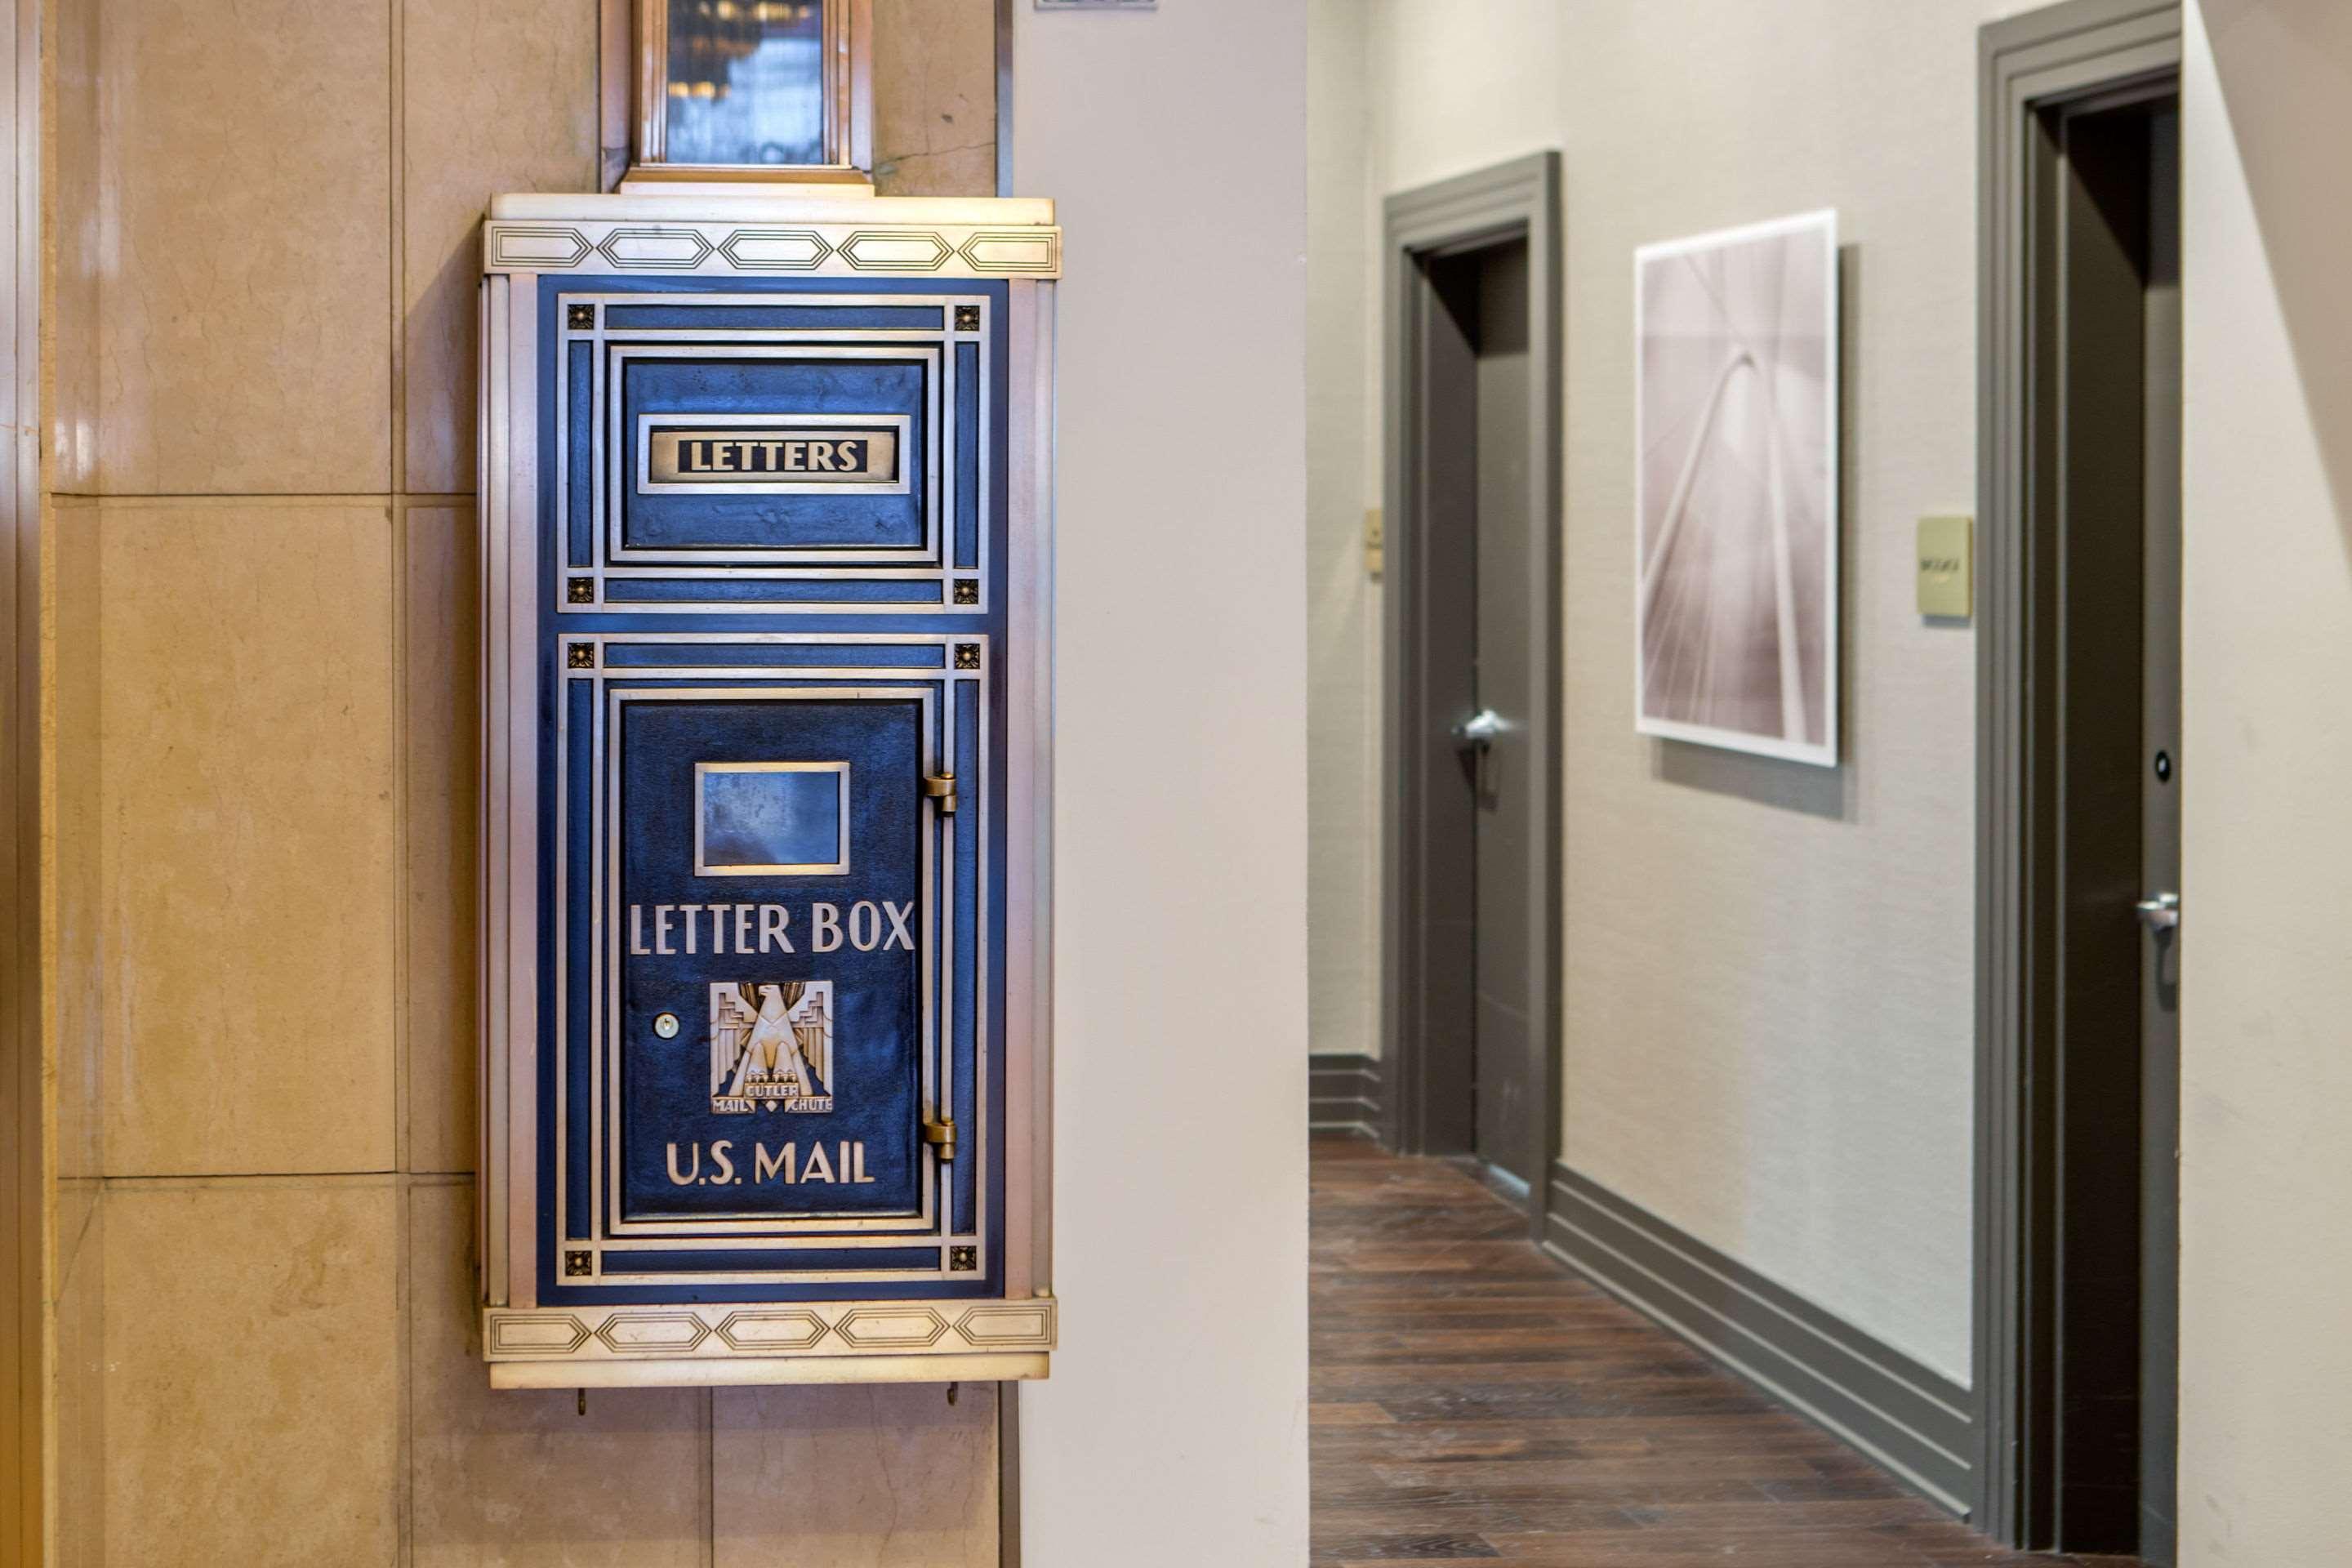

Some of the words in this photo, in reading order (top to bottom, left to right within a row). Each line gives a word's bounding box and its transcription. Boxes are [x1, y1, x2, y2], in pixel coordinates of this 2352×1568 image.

[691, 441, 858, 471] LETTERS
[630, 904, 795, 954] LETTER
[812, 900, 915, 953] BOX
[713, 1099, 748, 1111] MAIL
[791, 1099, 832, 1111] CHUTE
[745, 1085, 798, 1098] CUTLER
[666, 1139, 742, 1185] U.S.
[755, 1141, 875, 1185] MAIL
